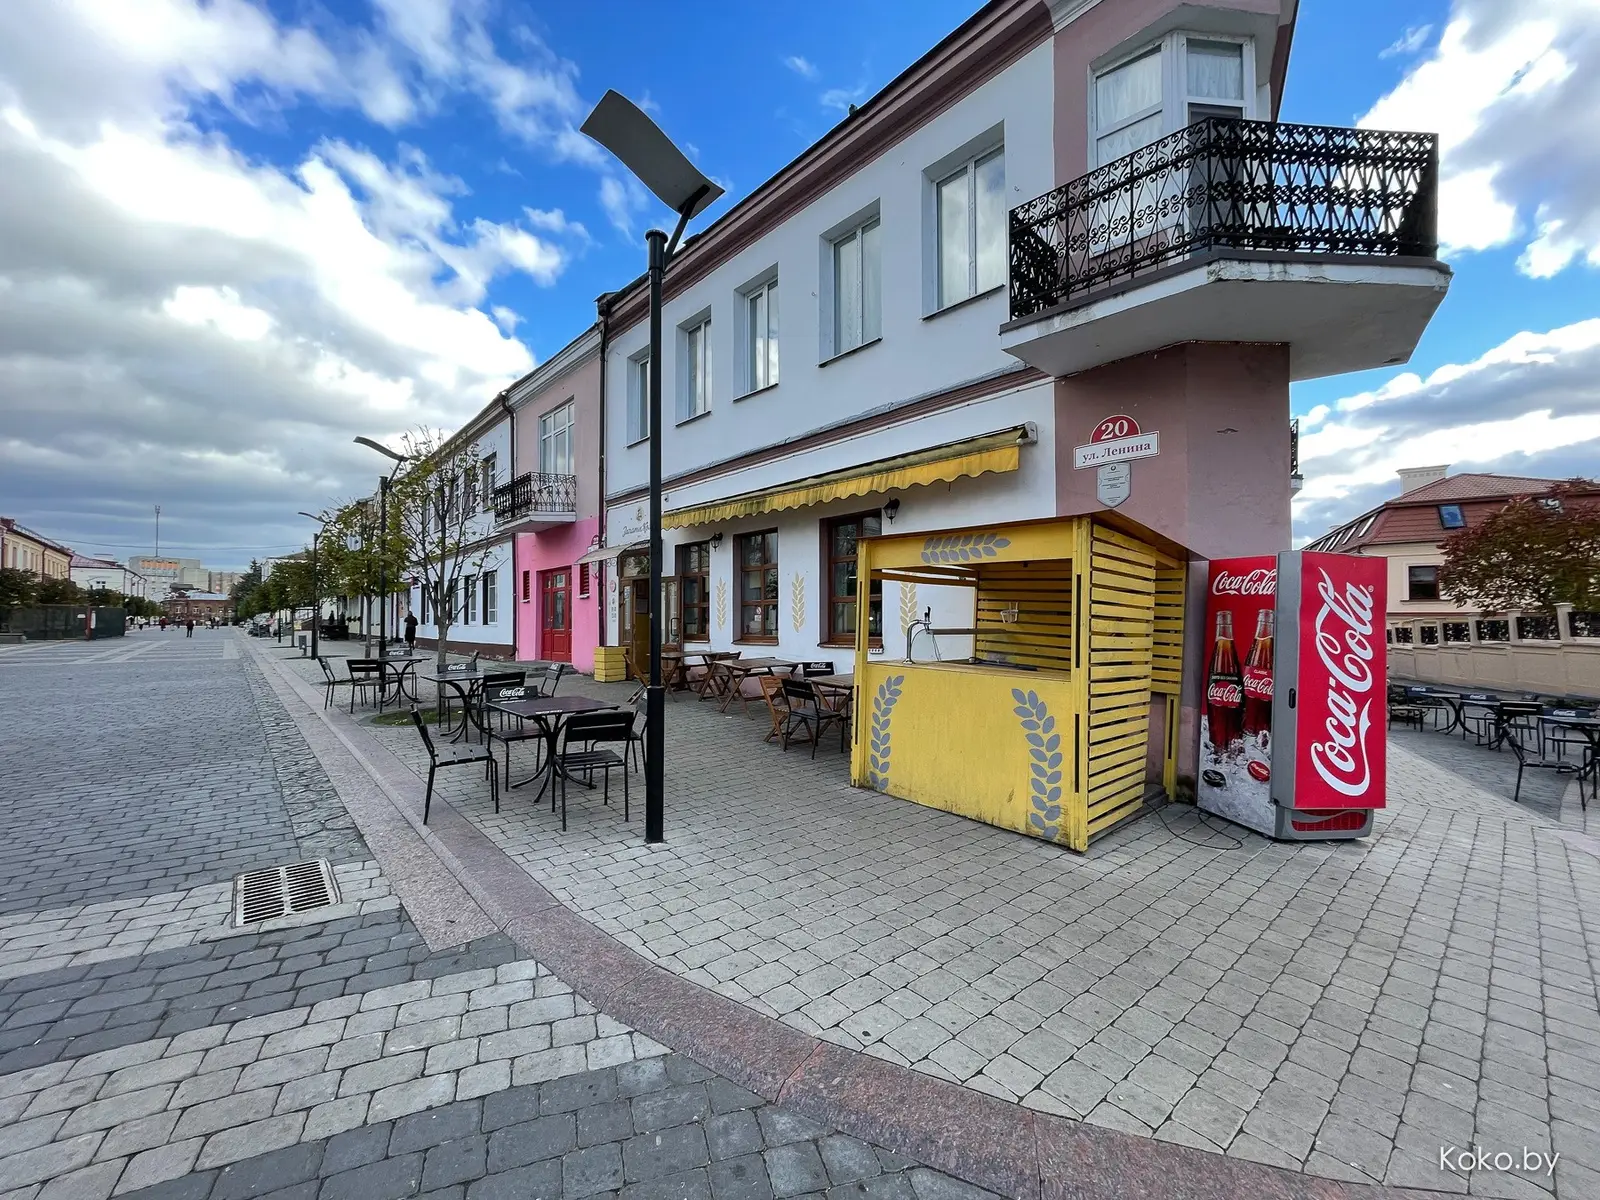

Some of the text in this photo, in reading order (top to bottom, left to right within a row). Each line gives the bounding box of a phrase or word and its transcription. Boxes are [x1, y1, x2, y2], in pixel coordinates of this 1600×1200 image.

[1101, 420, 1128, 439] 20
[1082, 443, 1151, 463] ул. Ленина
[1212, 569, 1276, 596] Coca-Cola
[1310, 566, 1374, 796] Coca-Cola
[500, 687, 526, 697] Coca-Cola
[1208, 683, 1242, 703] Coca-Cola
